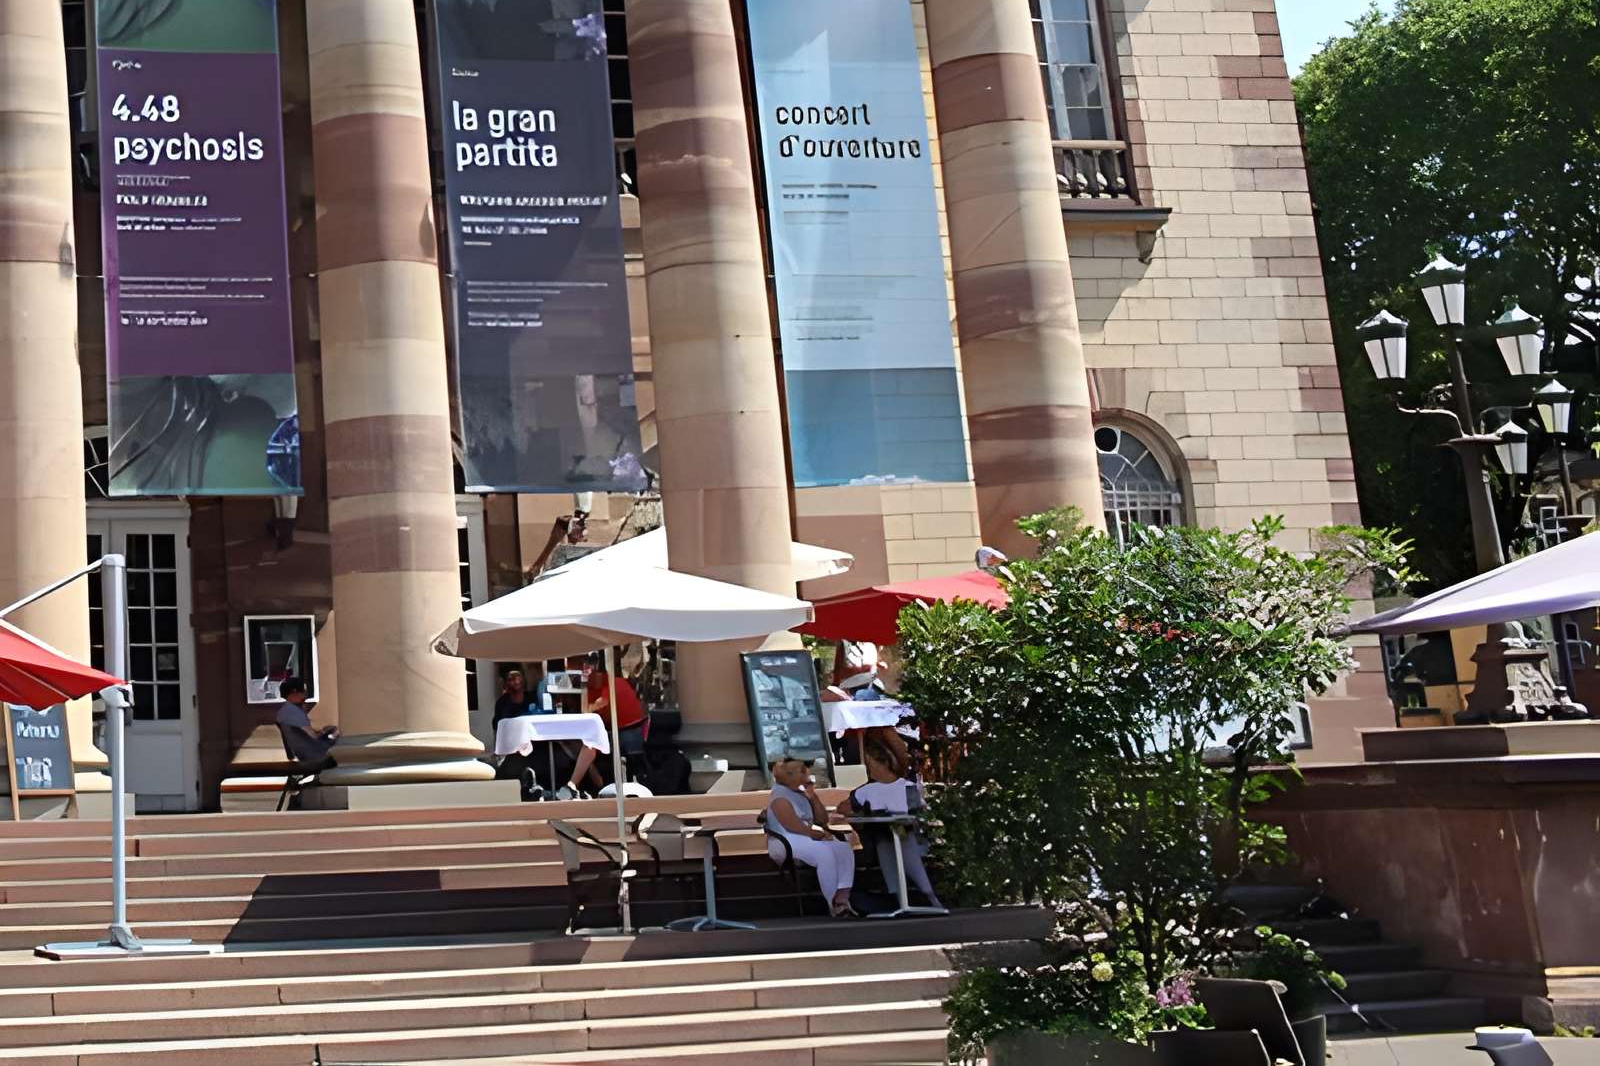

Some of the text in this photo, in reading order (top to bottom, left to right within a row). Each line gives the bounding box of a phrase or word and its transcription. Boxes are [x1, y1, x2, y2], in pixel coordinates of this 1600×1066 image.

[112, 94, 181, 122] 4.48
[452, 100, 557, 138] la gran
[113, 131, 265, 165] psychosis
[456, 137, 558, 172] partita
